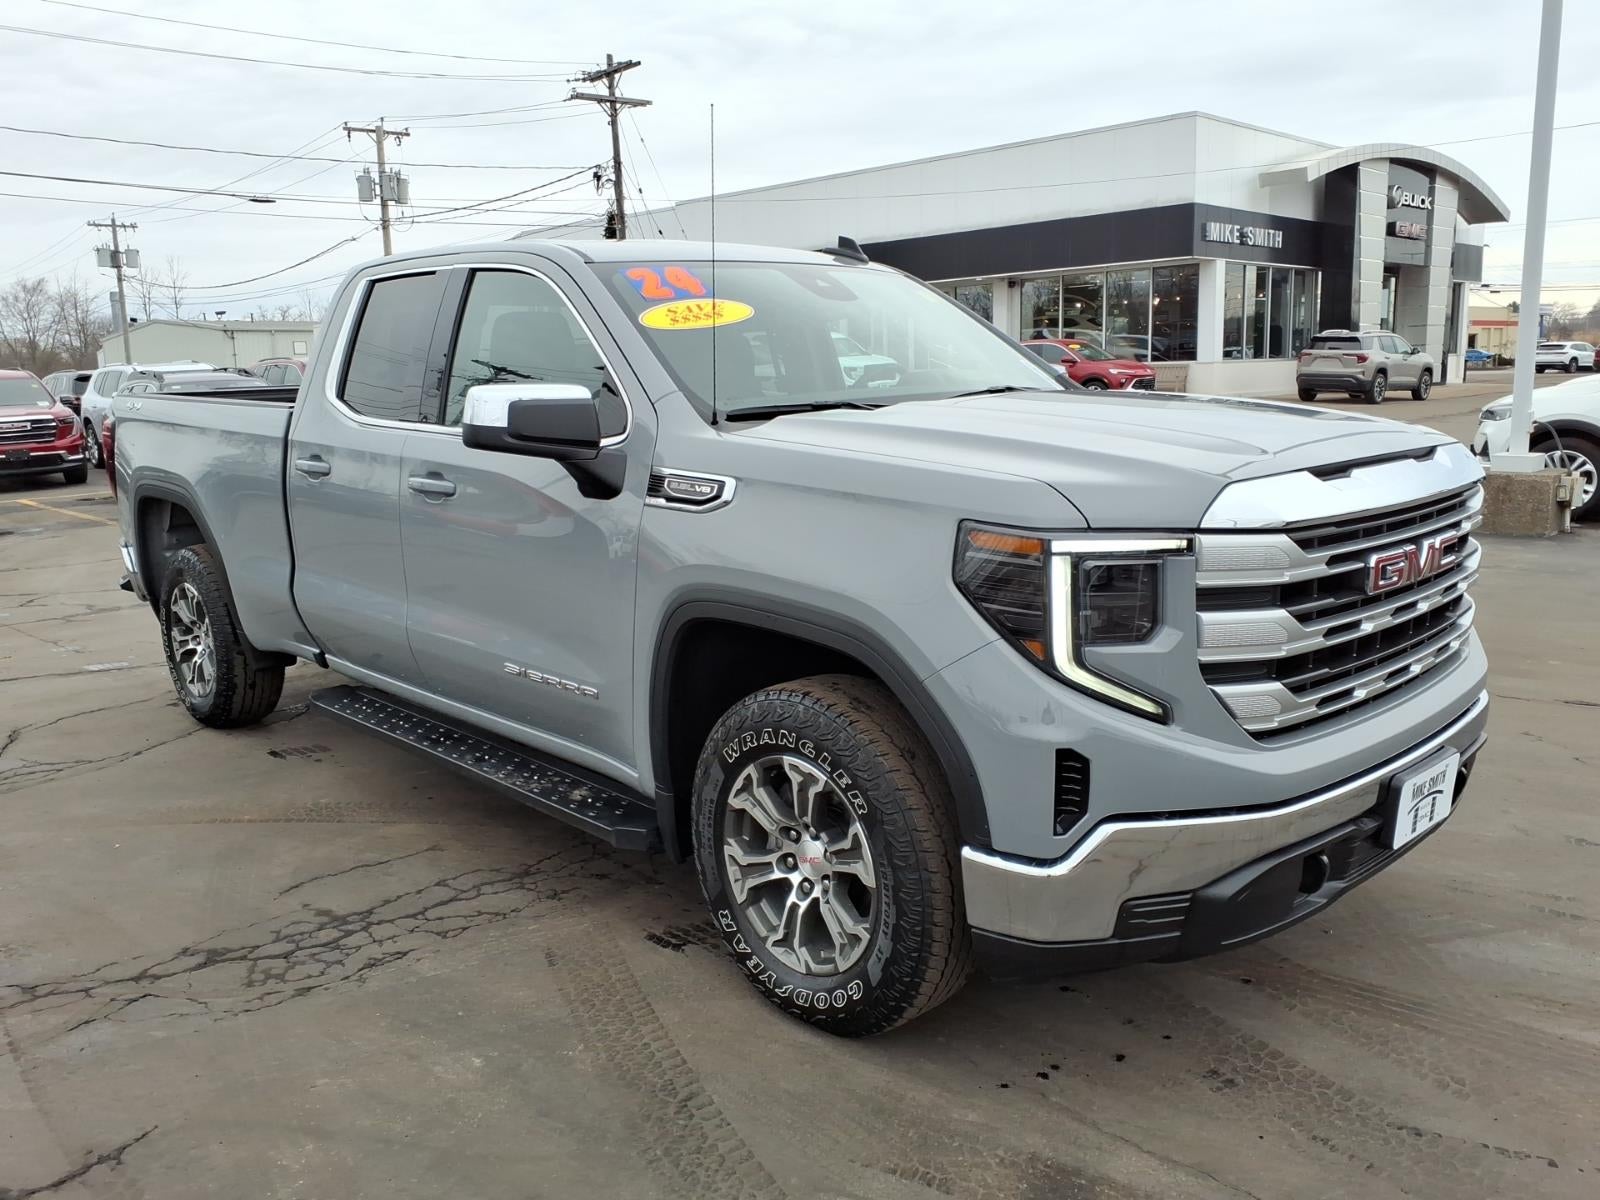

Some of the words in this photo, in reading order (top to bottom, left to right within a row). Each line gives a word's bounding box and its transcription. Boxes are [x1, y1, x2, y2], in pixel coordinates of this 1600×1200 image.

[1402, 191, 1432, 210] BUICK
[1206, 222, 1240, 244] MIKE
[1243, 226, 1283, 249] SMITH
[1364, 530, 1460, 596] GMC
[503, 662, 599, 700] SIERRA
[723, 728, 868, 816] WRANGLER
[1412, 780, 1428, 802] MIKE
[1428, 769, 1447, 791] SMITH
[718, 909, 864, 1010] GOODYEAR
